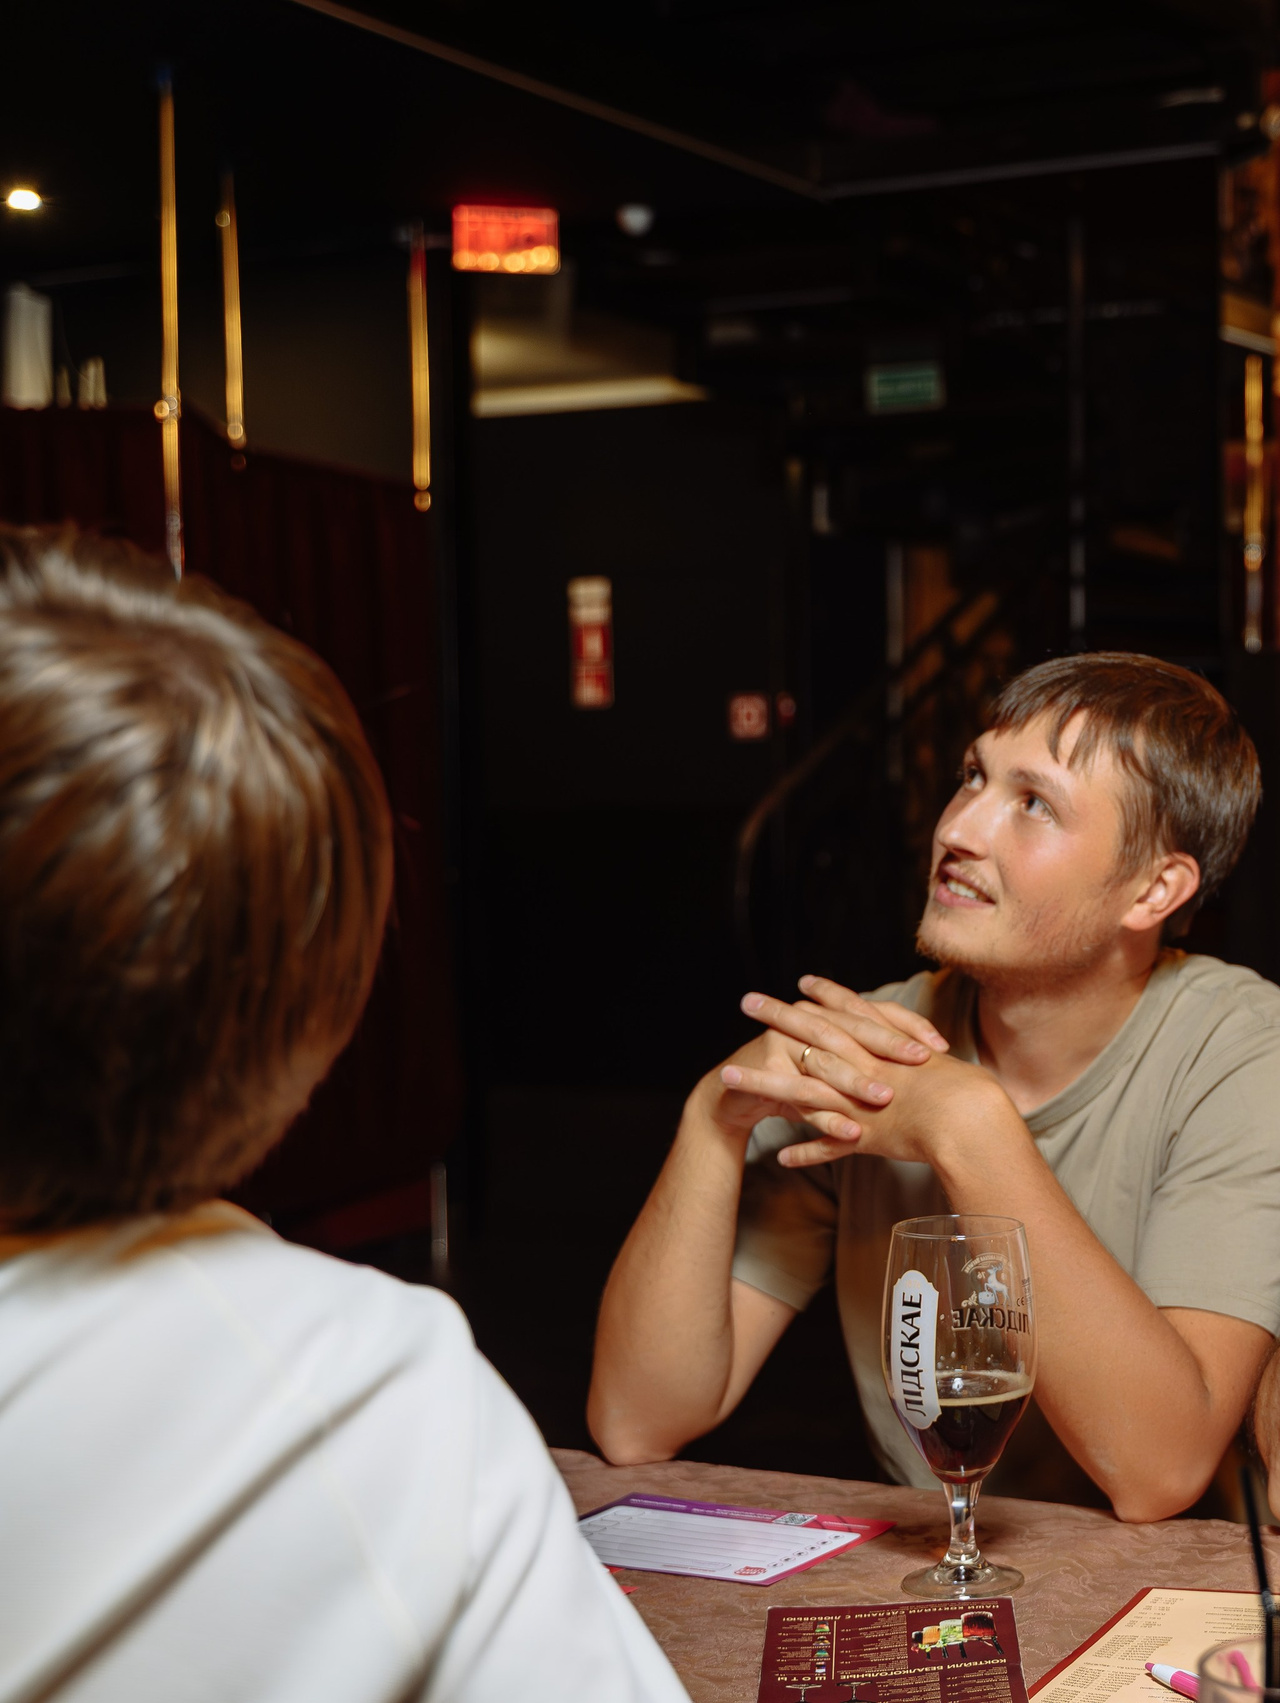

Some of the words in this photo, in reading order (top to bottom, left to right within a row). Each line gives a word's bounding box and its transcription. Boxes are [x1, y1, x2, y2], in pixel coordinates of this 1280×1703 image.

[900, 1291, 927, 1417] ЛІДСКАЕ
[946, 1658, 1007, 1670] КОКТЕЙЛИ
[840, 1665, 944, 1680] БЕЗАЛКОГОЛЬНЫЕ
